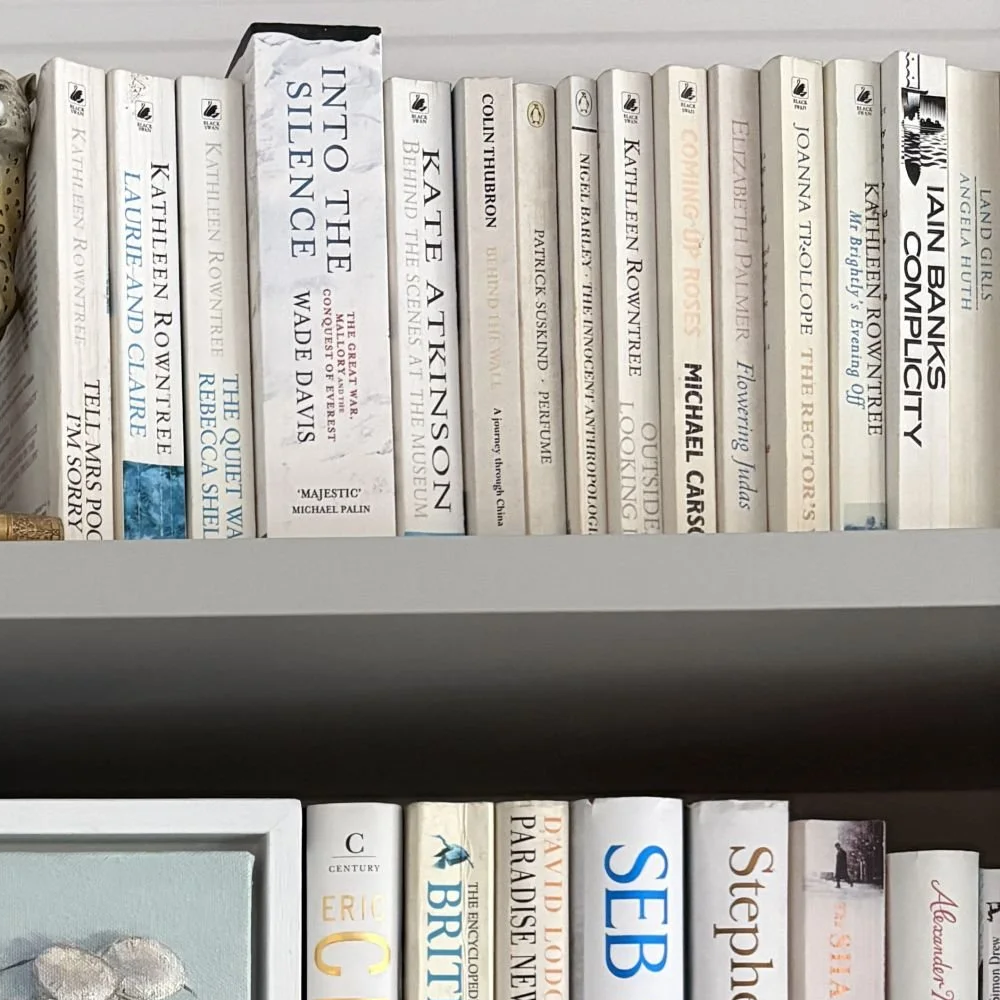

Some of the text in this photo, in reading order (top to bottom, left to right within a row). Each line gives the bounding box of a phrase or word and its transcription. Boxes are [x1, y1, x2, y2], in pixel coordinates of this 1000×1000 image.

[286, 81, 316, 259] SILENCE
[321, 66, 352, 274] INTO THE
[482, 94, 498, 229] COLIN THUBRON
[624, 139, 641, 252] KATHLEEN
[792, 121, 813, 213] JOANNA
[124, 171, 147, 438] LAURIE AND CLAIRE
[579, 153, 597, 403] NIGEL BARLEY THE INNOCENT
[926, 185, 947, 391] IAIN BANKS
[960, 172, 973, 311] ANGELA HUTH
[980, 188, 994, 302] LAND GIRLS
[151, 162, 172, 456] KATHLEEN ROWNTREE
[293, 290, 316, 444] WADE DAVIS
[321, 288, 337, 443] CONQUEST EVEREST
[336, 314, 346, 376] MALLORY
[348, 343, 357, 386] GREAT
[422, 149, 452, 513] KATE ATKINSON
[534, 230, 553, 465] PATRICK PERFUME
[626, 257, 643, 377] ROWNTREE
[846, 210, 867, 410] Mr Evening Off
[864, 181, 883, 436] KATHLEEN ROWNTREE
[903, 230, 924, 448] COMPLICITY
[84, 380, 102, 490] TELL MRS
[199, 372, 220, 477] REBECCA
[220, 373, 242, 500] THE QUIET
[491, 418, 506, 528] journey through China
[684, 362, 705, 463] MICHAEL
[731, 360, 759, 511] Flowering Judas
[67, 456, 83, 533] SORRY
[292, 504, 370, 514] MICHAEL PALIN
[329, 864, 381, 873] CENTURY
[468, 882, 479, 909] THE
[510, 816, 537, 946] PARADISE
[544, 817, 563, 913] DAVID
[604, 845, 669, 979] SEB
[930, 880, 959, 987] Alexander
